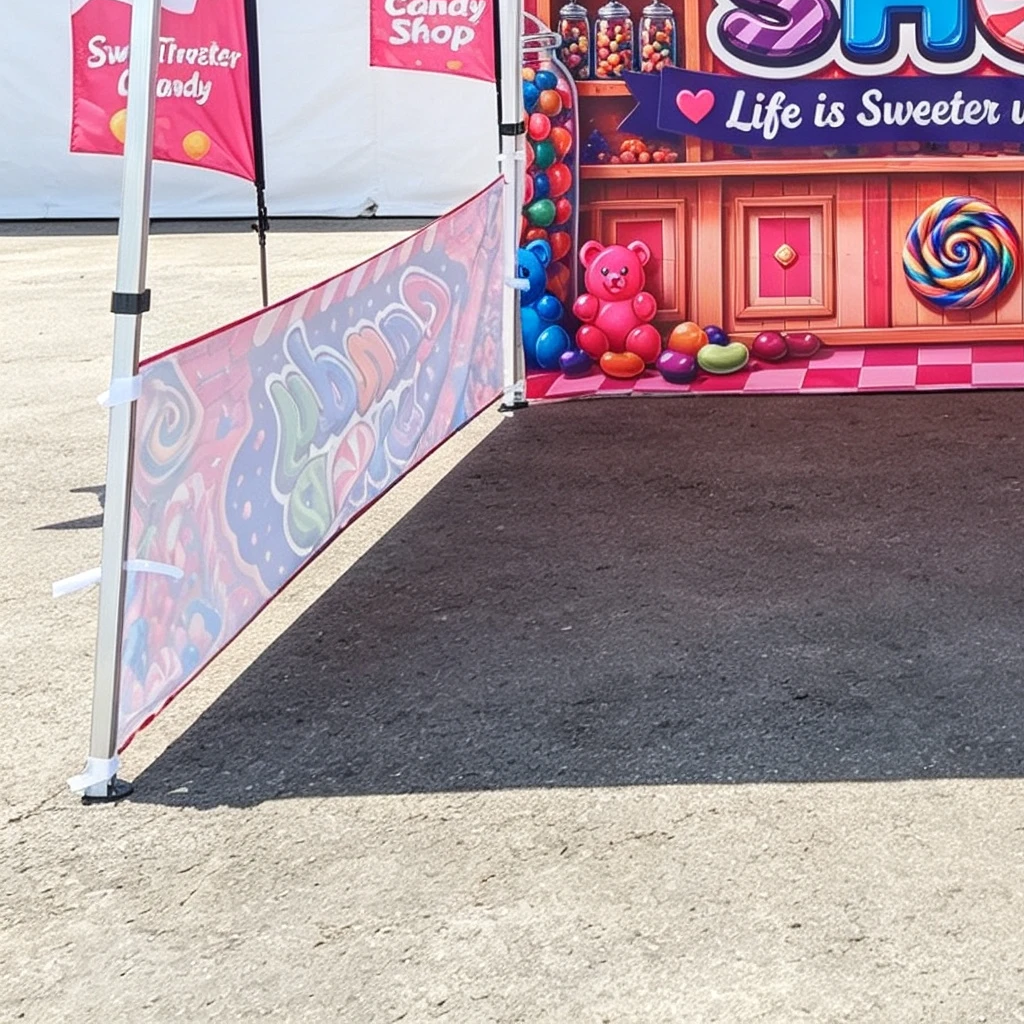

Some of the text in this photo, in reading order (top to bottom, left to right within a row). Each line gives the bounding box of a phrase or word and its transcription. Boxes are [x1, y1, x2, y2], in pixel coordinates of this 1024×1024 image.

[388, 17, 475, 52] Shop
[726, 89, 802, 140] Life
[814, 92, 846, 128] is
[857, 88, 1001, 126] Sweeter
